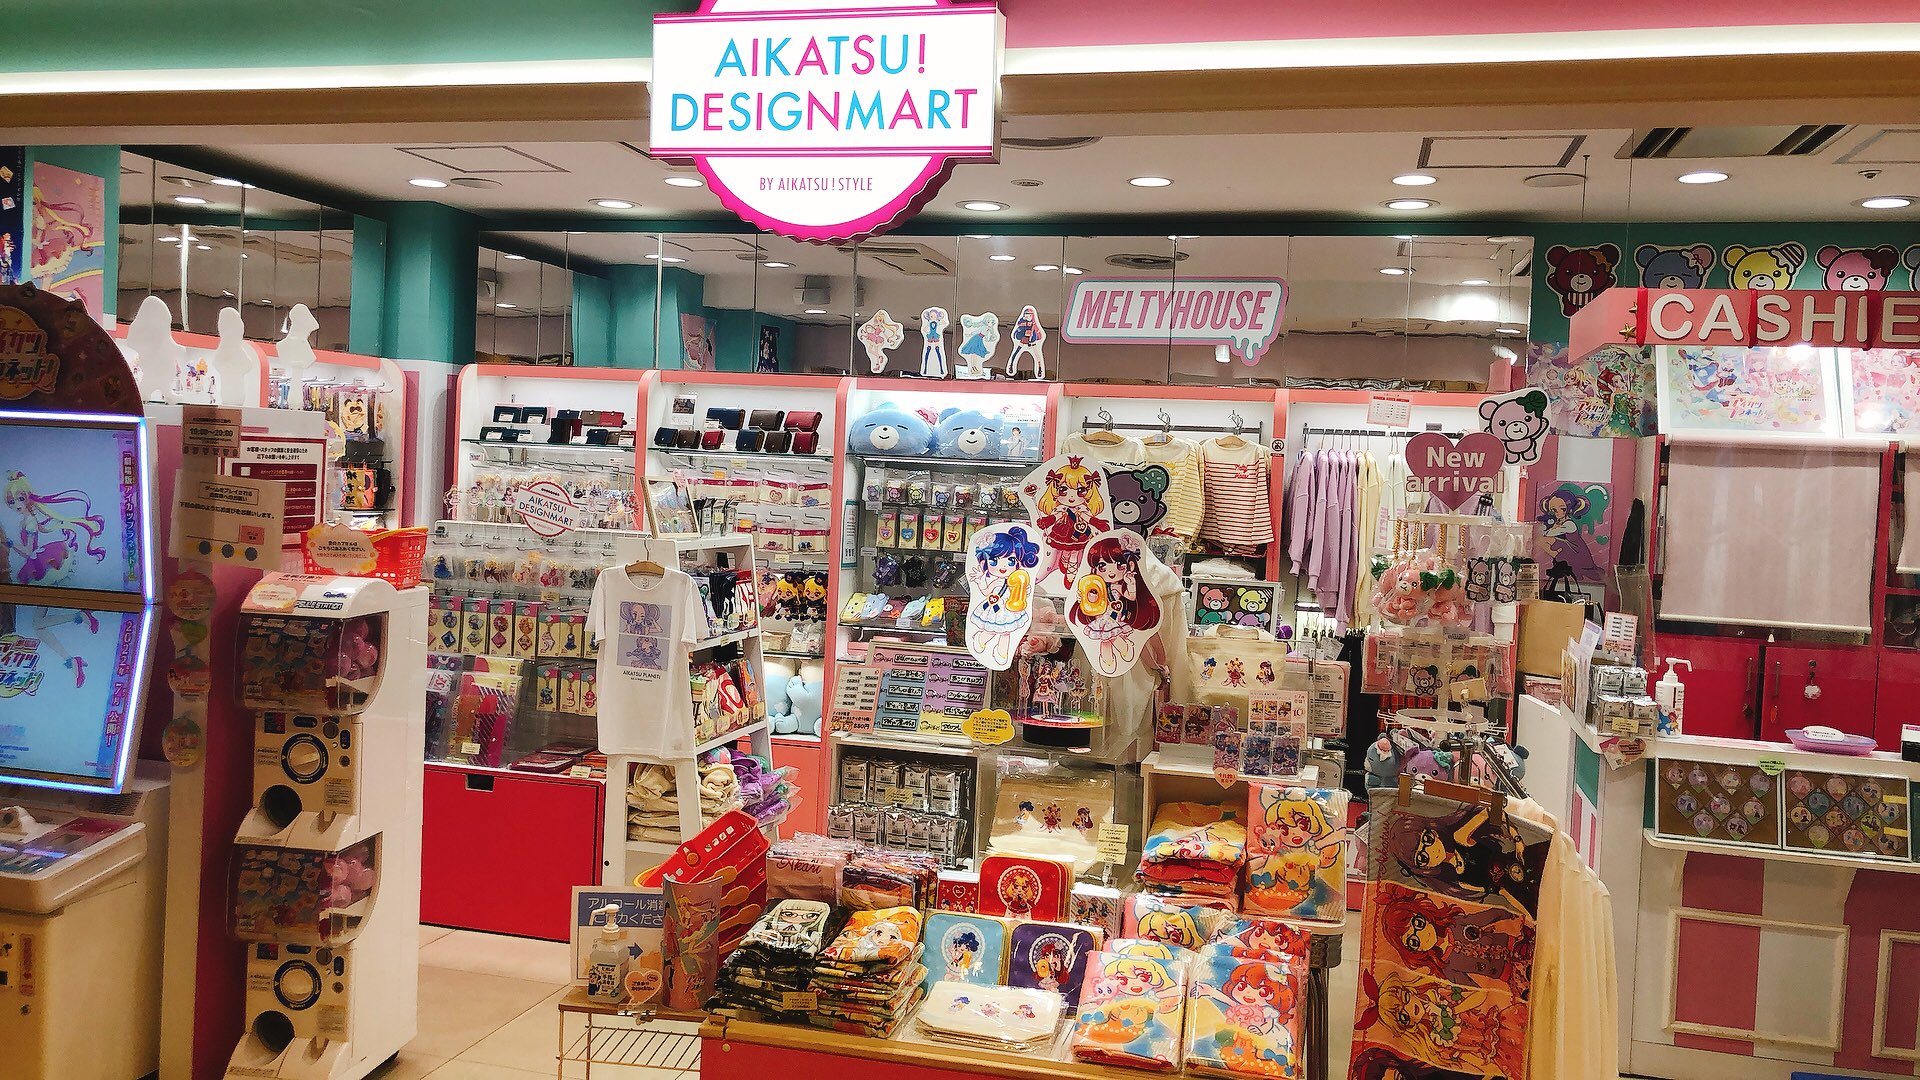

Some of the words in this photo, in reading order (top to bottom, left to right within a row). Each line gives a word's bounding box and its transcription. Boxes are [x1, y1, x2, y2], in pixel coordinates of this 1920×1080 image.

[714, 33, 926, 77] AIKATSU!
[671, 88, 978, 132] DESIGNMART
[759, 177, 774, 191] BY
[1076, 290, 1273, 331] MELTYHOUSE
[1426, 446, 1485, 468] New
[1406, 470, 1505, 494] arrival
[519, 501, 574, 526] DESIGNMART
[528, 495, 567, 515] AIKATSU!
